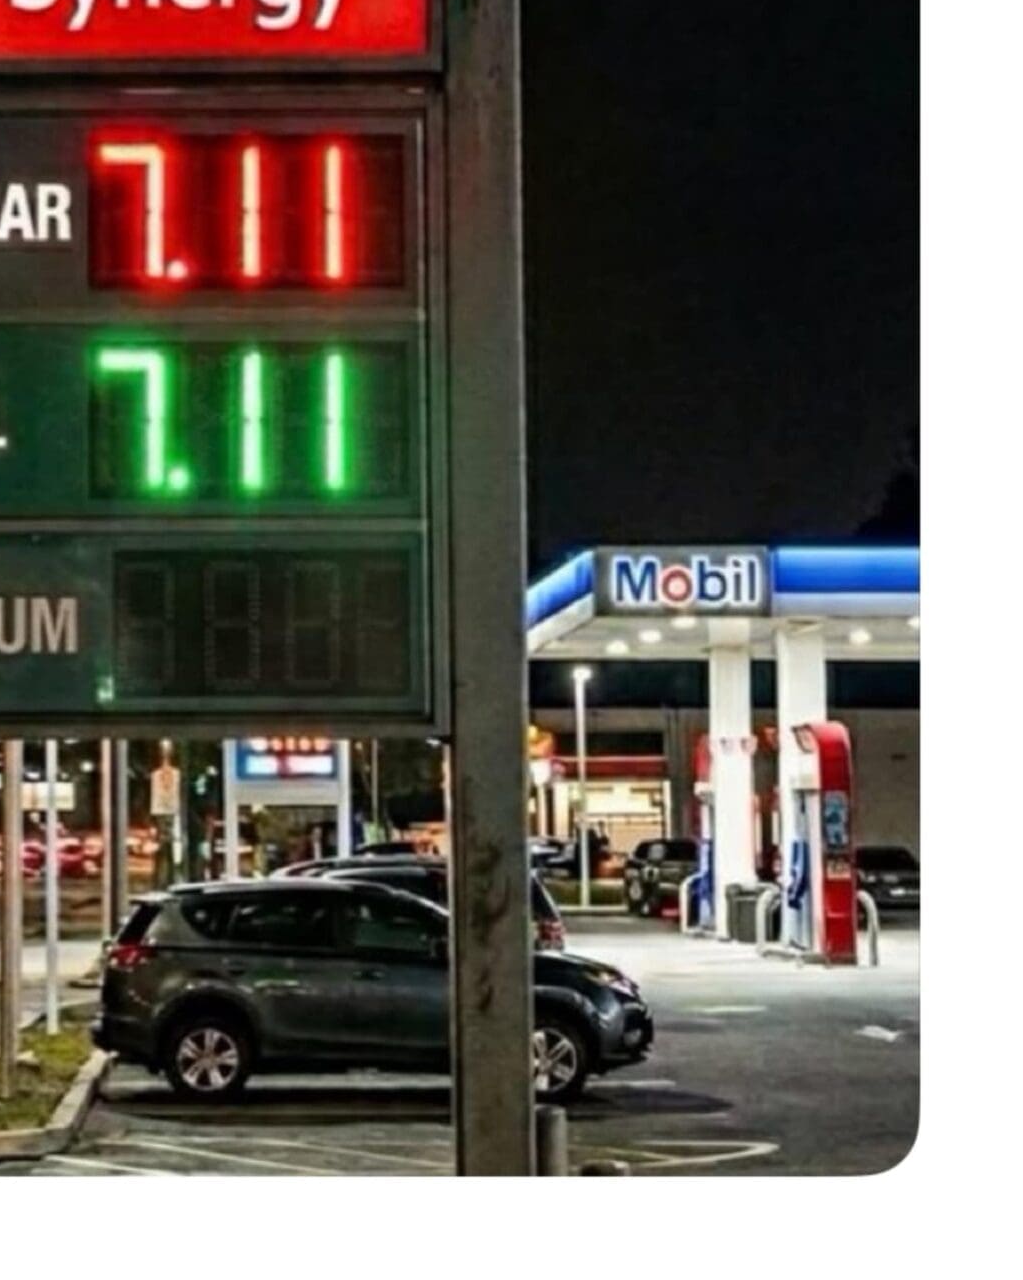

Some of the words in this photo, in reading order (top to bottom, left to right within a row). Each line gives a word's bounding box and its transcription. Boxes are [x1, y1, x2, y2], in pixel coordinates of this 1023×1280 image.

[98, 144, 344, 281] 7.11
[97, 350, 346, 491] 7.11
[614, 558, 758, 603] Mobil
